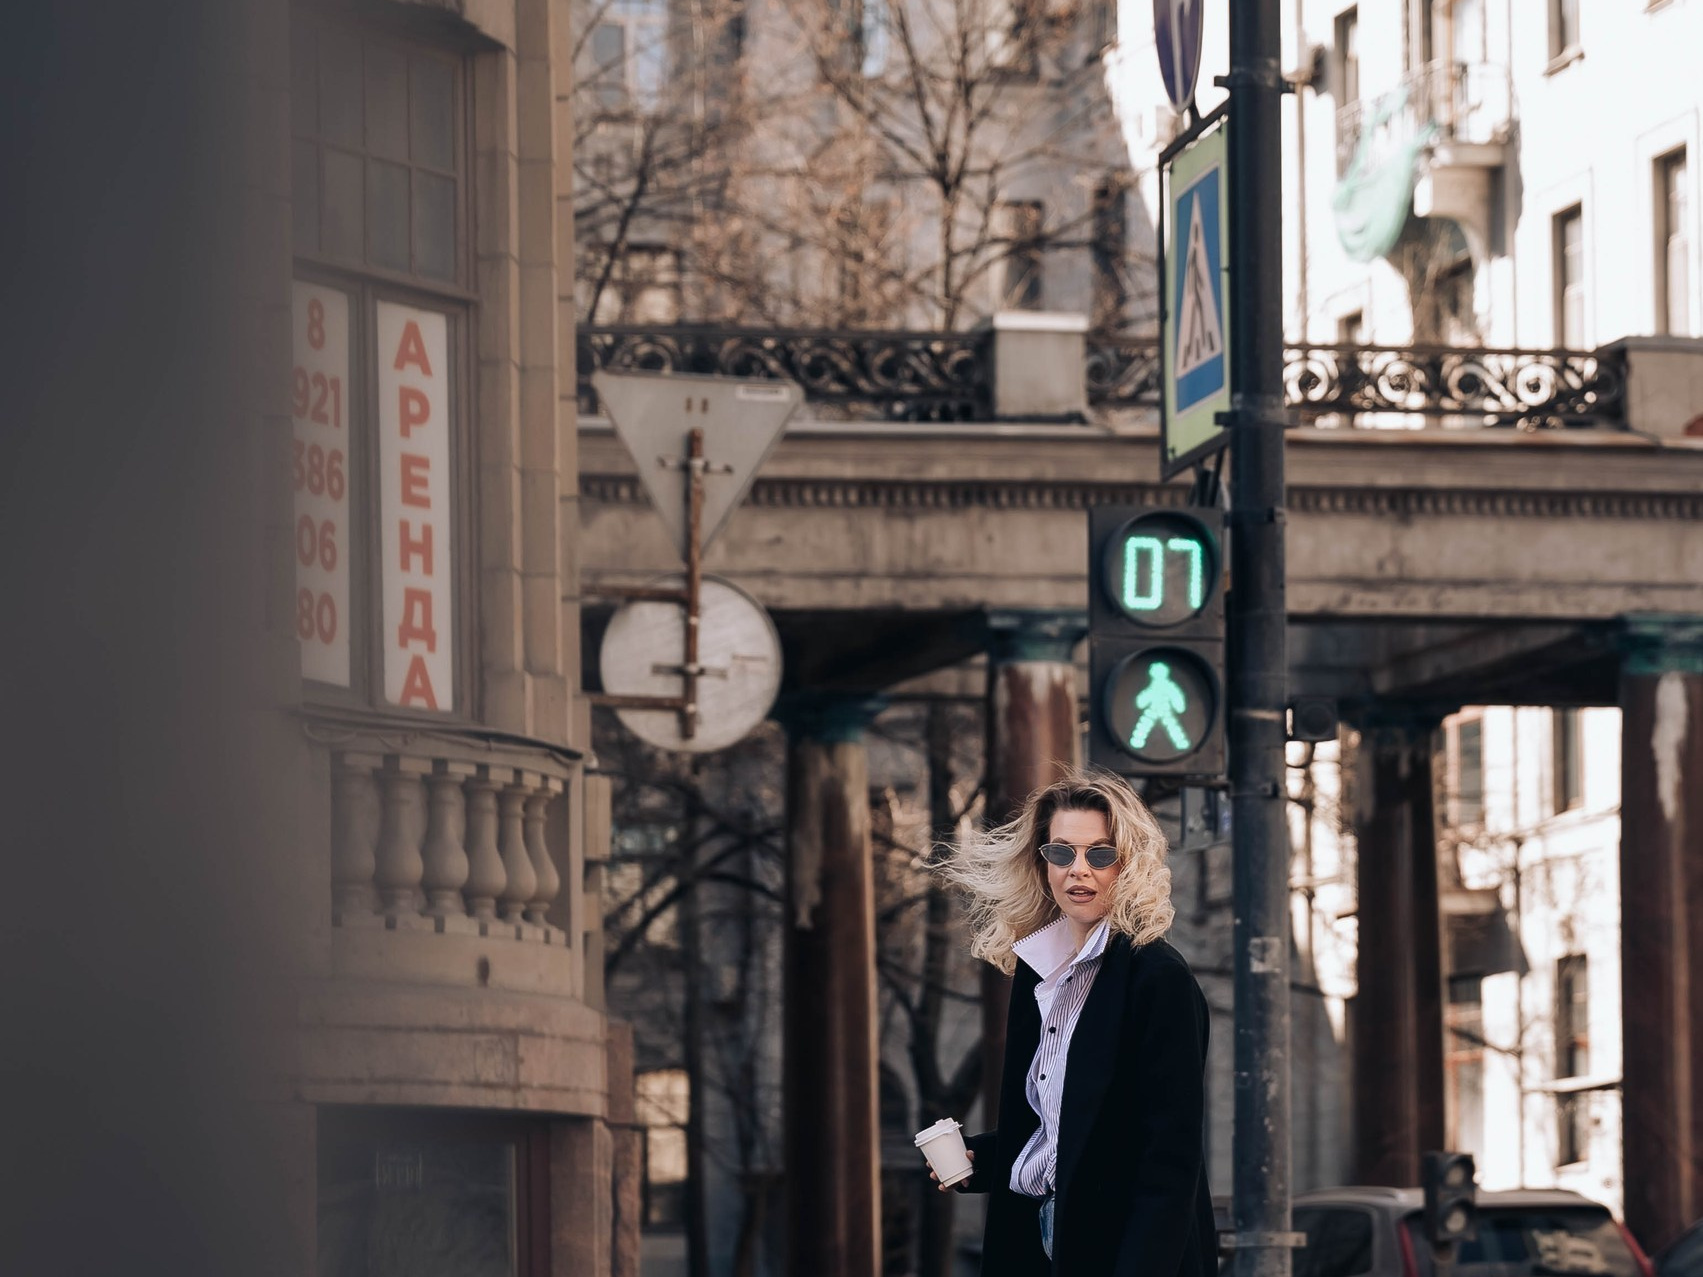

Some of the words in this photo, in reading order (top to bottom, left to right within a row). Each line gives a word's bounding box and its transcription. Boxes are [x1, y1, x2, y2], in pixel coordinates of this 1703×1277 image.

[307, 298, 326, 350] 8
[293, 365, 341, 429] 921
[297, 513, 337, 573] 06
[393, 319, 439, 711] АРЕНДА
[1123, 536, 1201, 610] 07
[298, 587, 337, 645] 80
